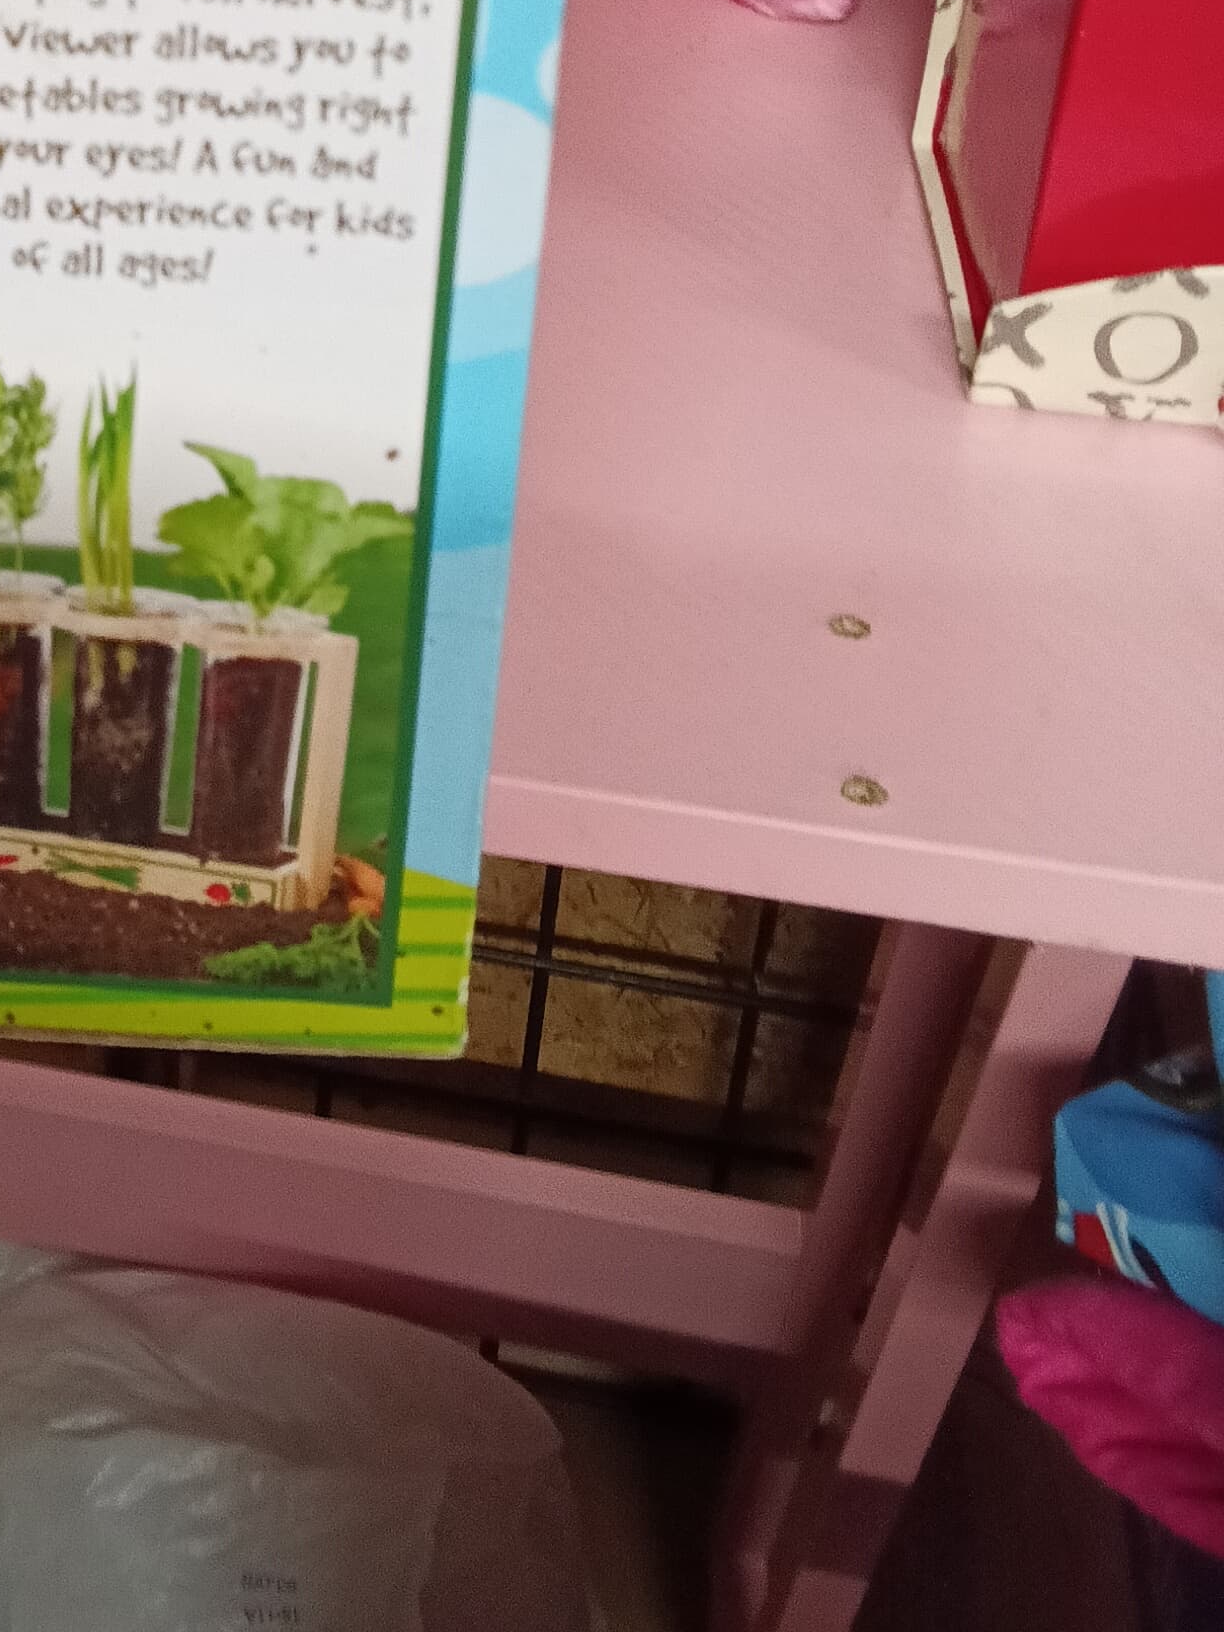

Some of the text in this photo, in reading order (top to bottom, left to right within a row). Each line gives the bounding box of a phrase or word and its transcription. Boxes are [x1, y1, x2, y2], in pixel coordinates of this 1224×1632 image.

[2, 21, 140, 58] viewer
[153, 24, 278, 65] allows
[287, 37, 356, 74] you
[369, 35, 411, 77] to
[155, 88, 305, 130] growing
[318, 95, 415, 136] right
[83, 138, 183, 178] eyes!
[194, 139, 219, 173] A
[231, 141, 297, 175] fun
[45, 196, 253, 230] experience
[265, 198, 322, 234] for
[334, 202, 414, 241] kids
[11, 241, 215, 288] of all ages!
